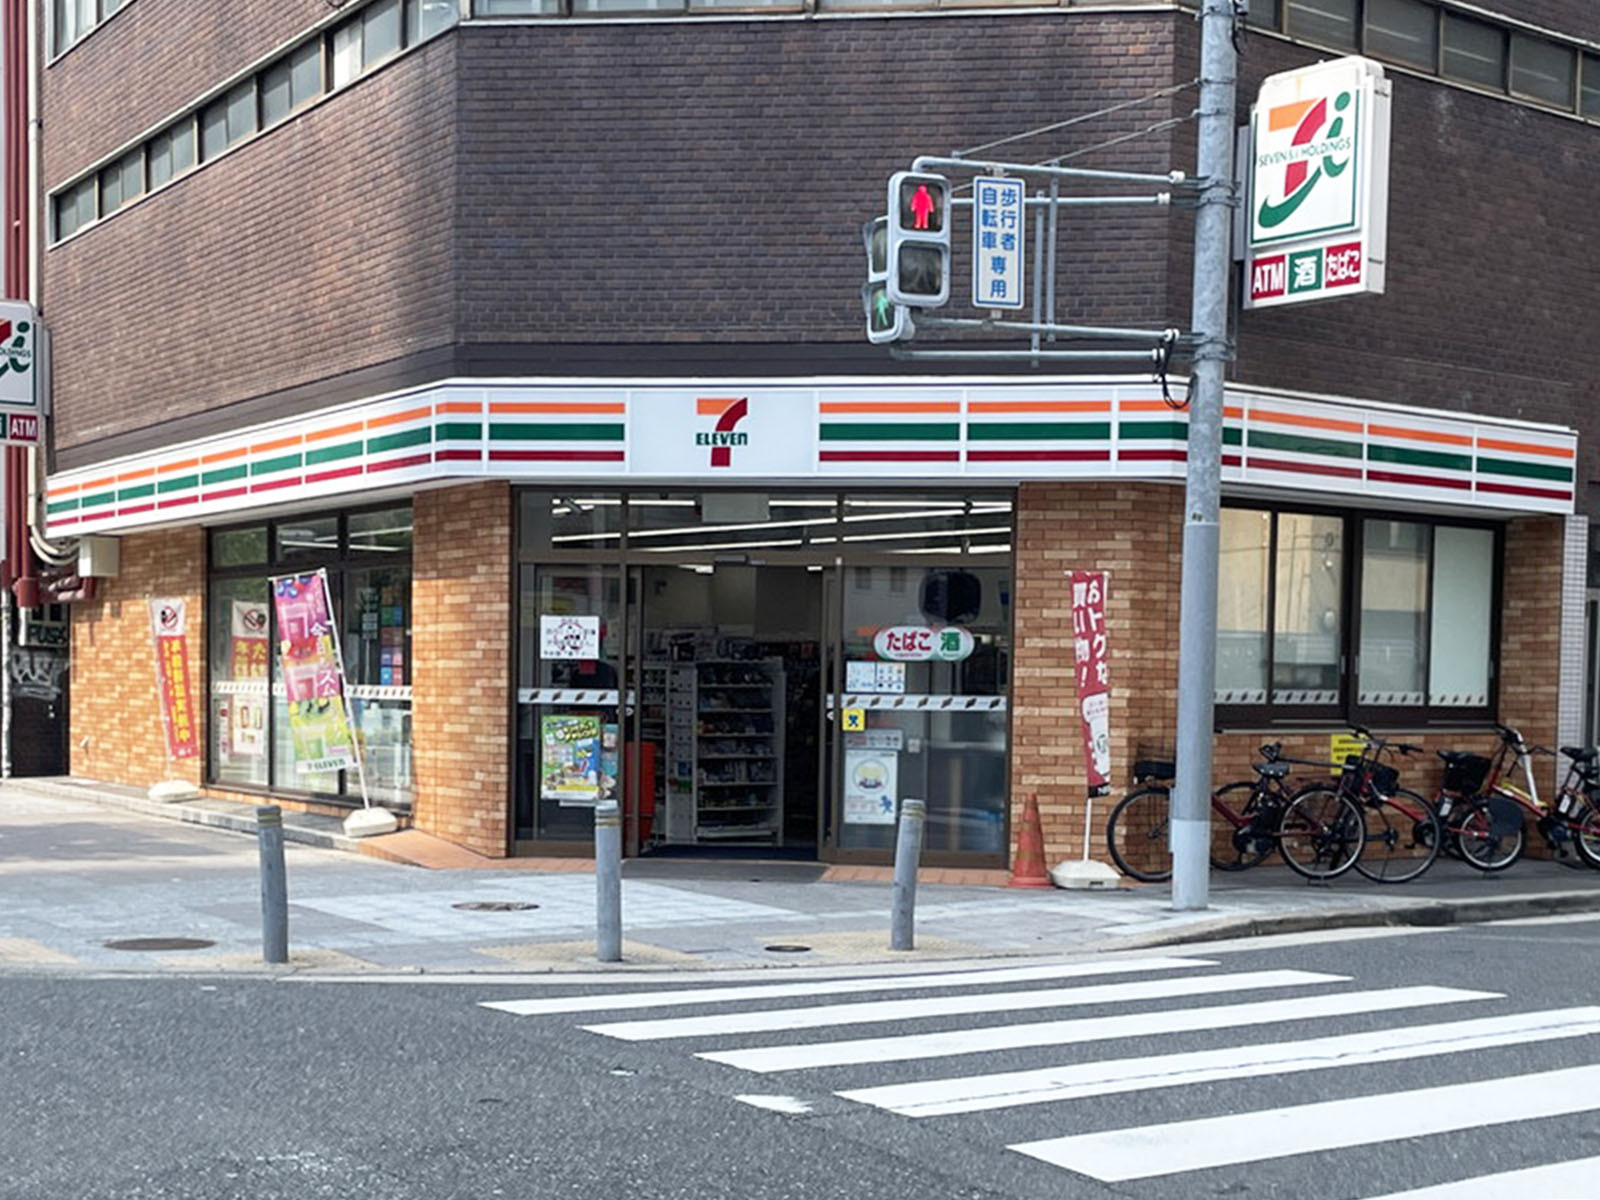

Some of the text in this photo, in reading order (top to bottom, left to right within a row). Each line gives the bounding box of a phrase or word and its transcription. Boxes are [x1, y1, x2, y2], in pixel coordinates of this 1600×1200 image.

[1258, 151, 1287, 167] SEVEN
[1300, 137, 1352, 157] HOLDINGS
[982, 187, 998, 250] 自転車
[1001, 187, 1017, 251] 歩行者
[991, 256, 1006, 298] 専用
[1253, 250, 1360, 292] ATM 酒 たばこ
[11, 418, 37, 438] ATM
[886, 631, 961, 652] たばこ 酒
[1087, 580, 1107, 686] おトクな
